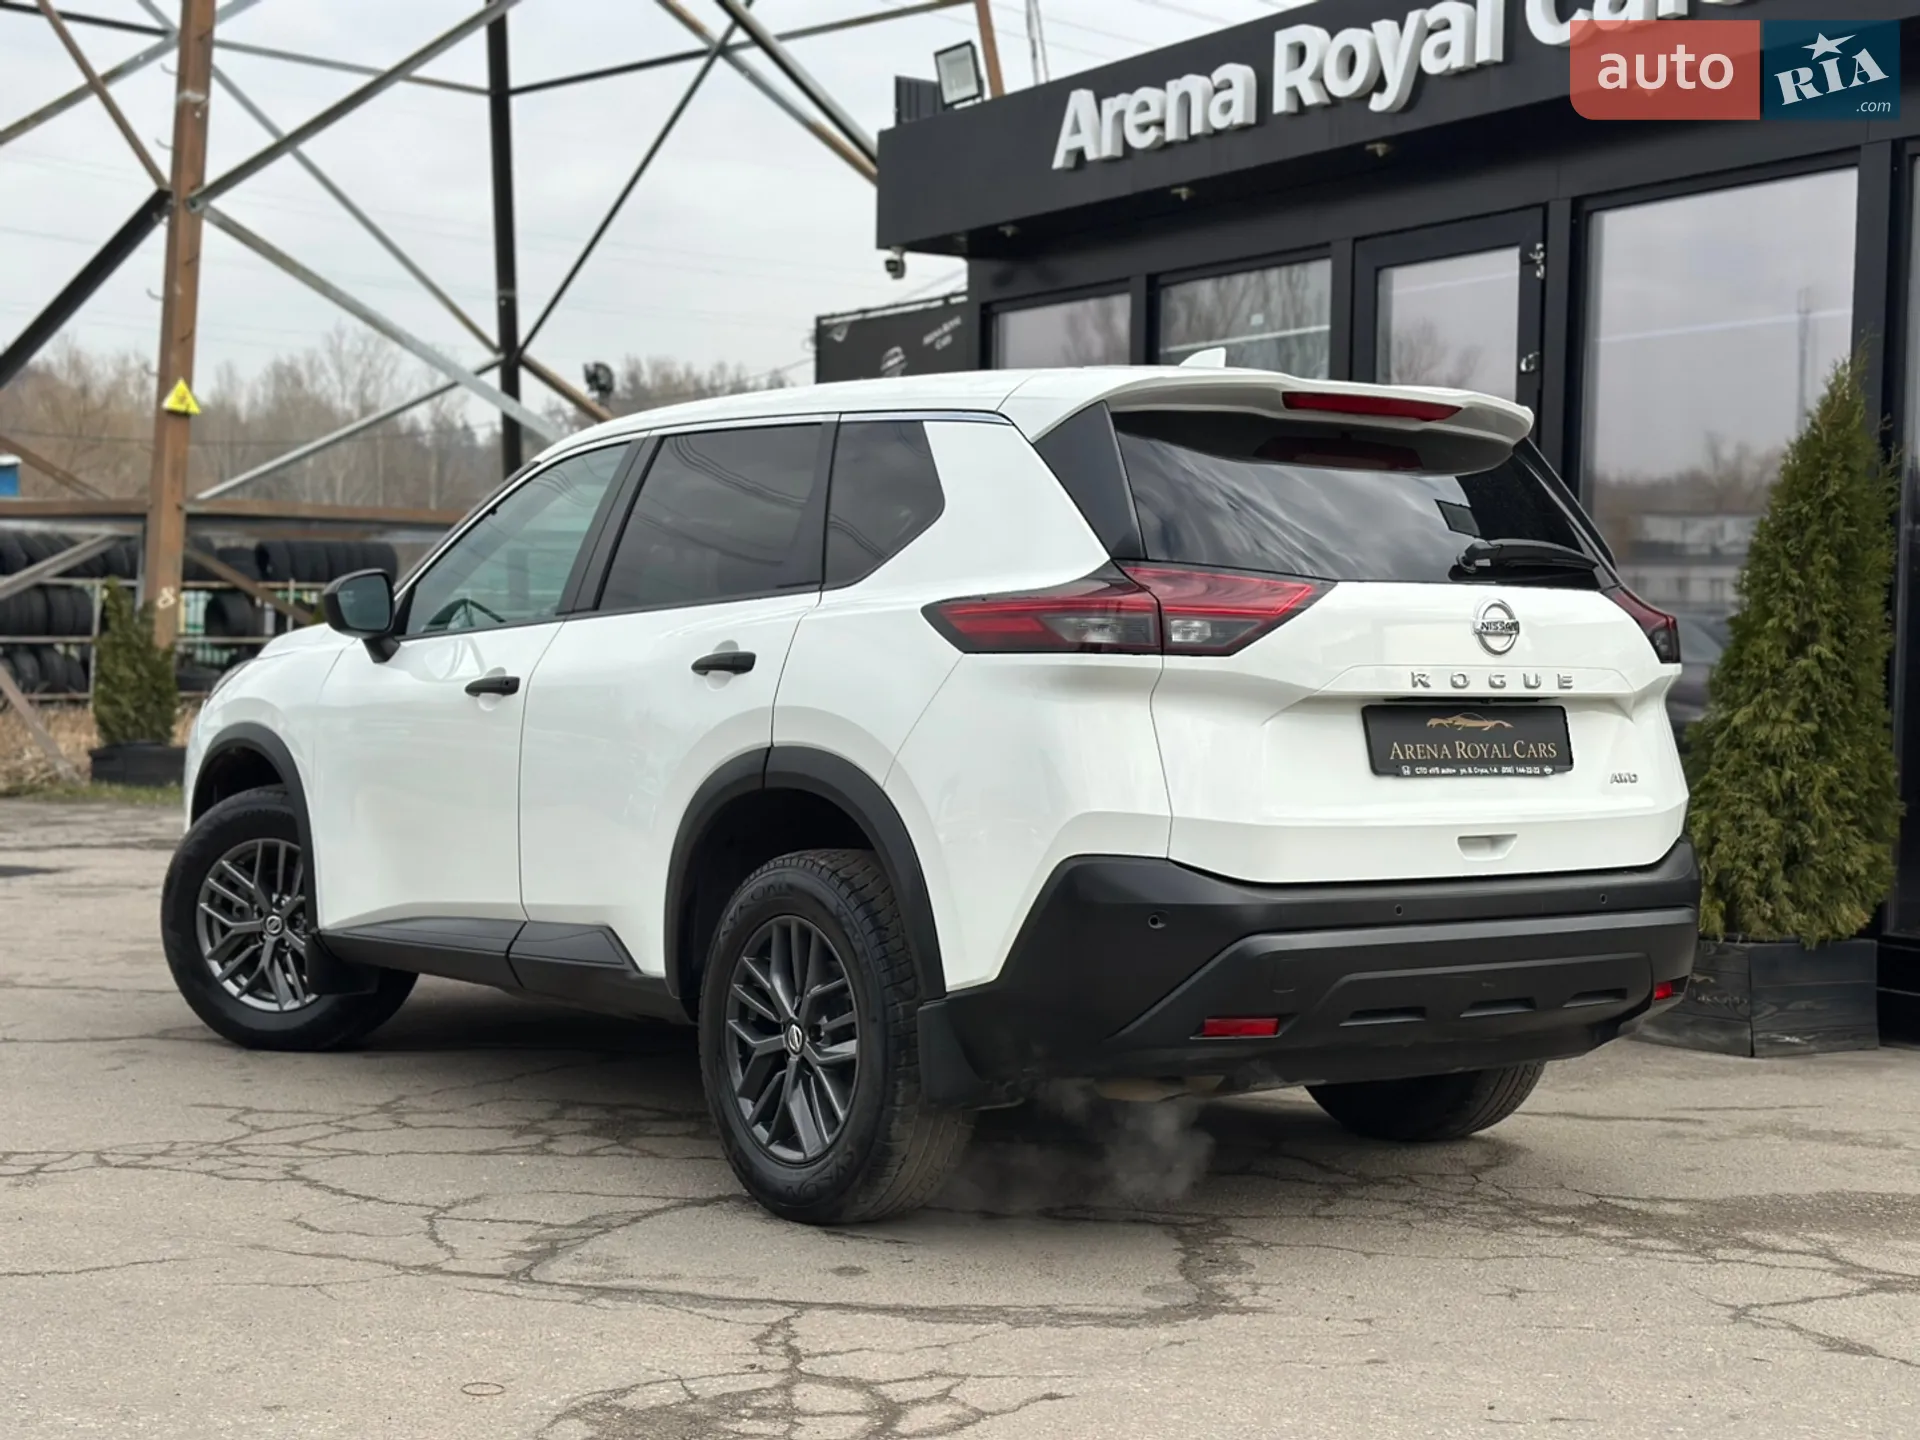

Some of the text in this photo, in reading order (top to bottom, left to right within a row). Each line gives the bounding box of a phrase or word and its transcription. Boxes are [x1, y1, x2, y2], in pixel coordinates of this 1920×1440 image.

[1051, 62, 1258, 170] Arena
[1272, 0, 1504, 113] Royal
[1480, 620, 1519, 632] NISSAN
[1410, 671, 1574, 690] ROGUE
[1389, 739, 1557, 760] ARENA ROYAL CARS
[1610, 772, 1638, 784] AWD
